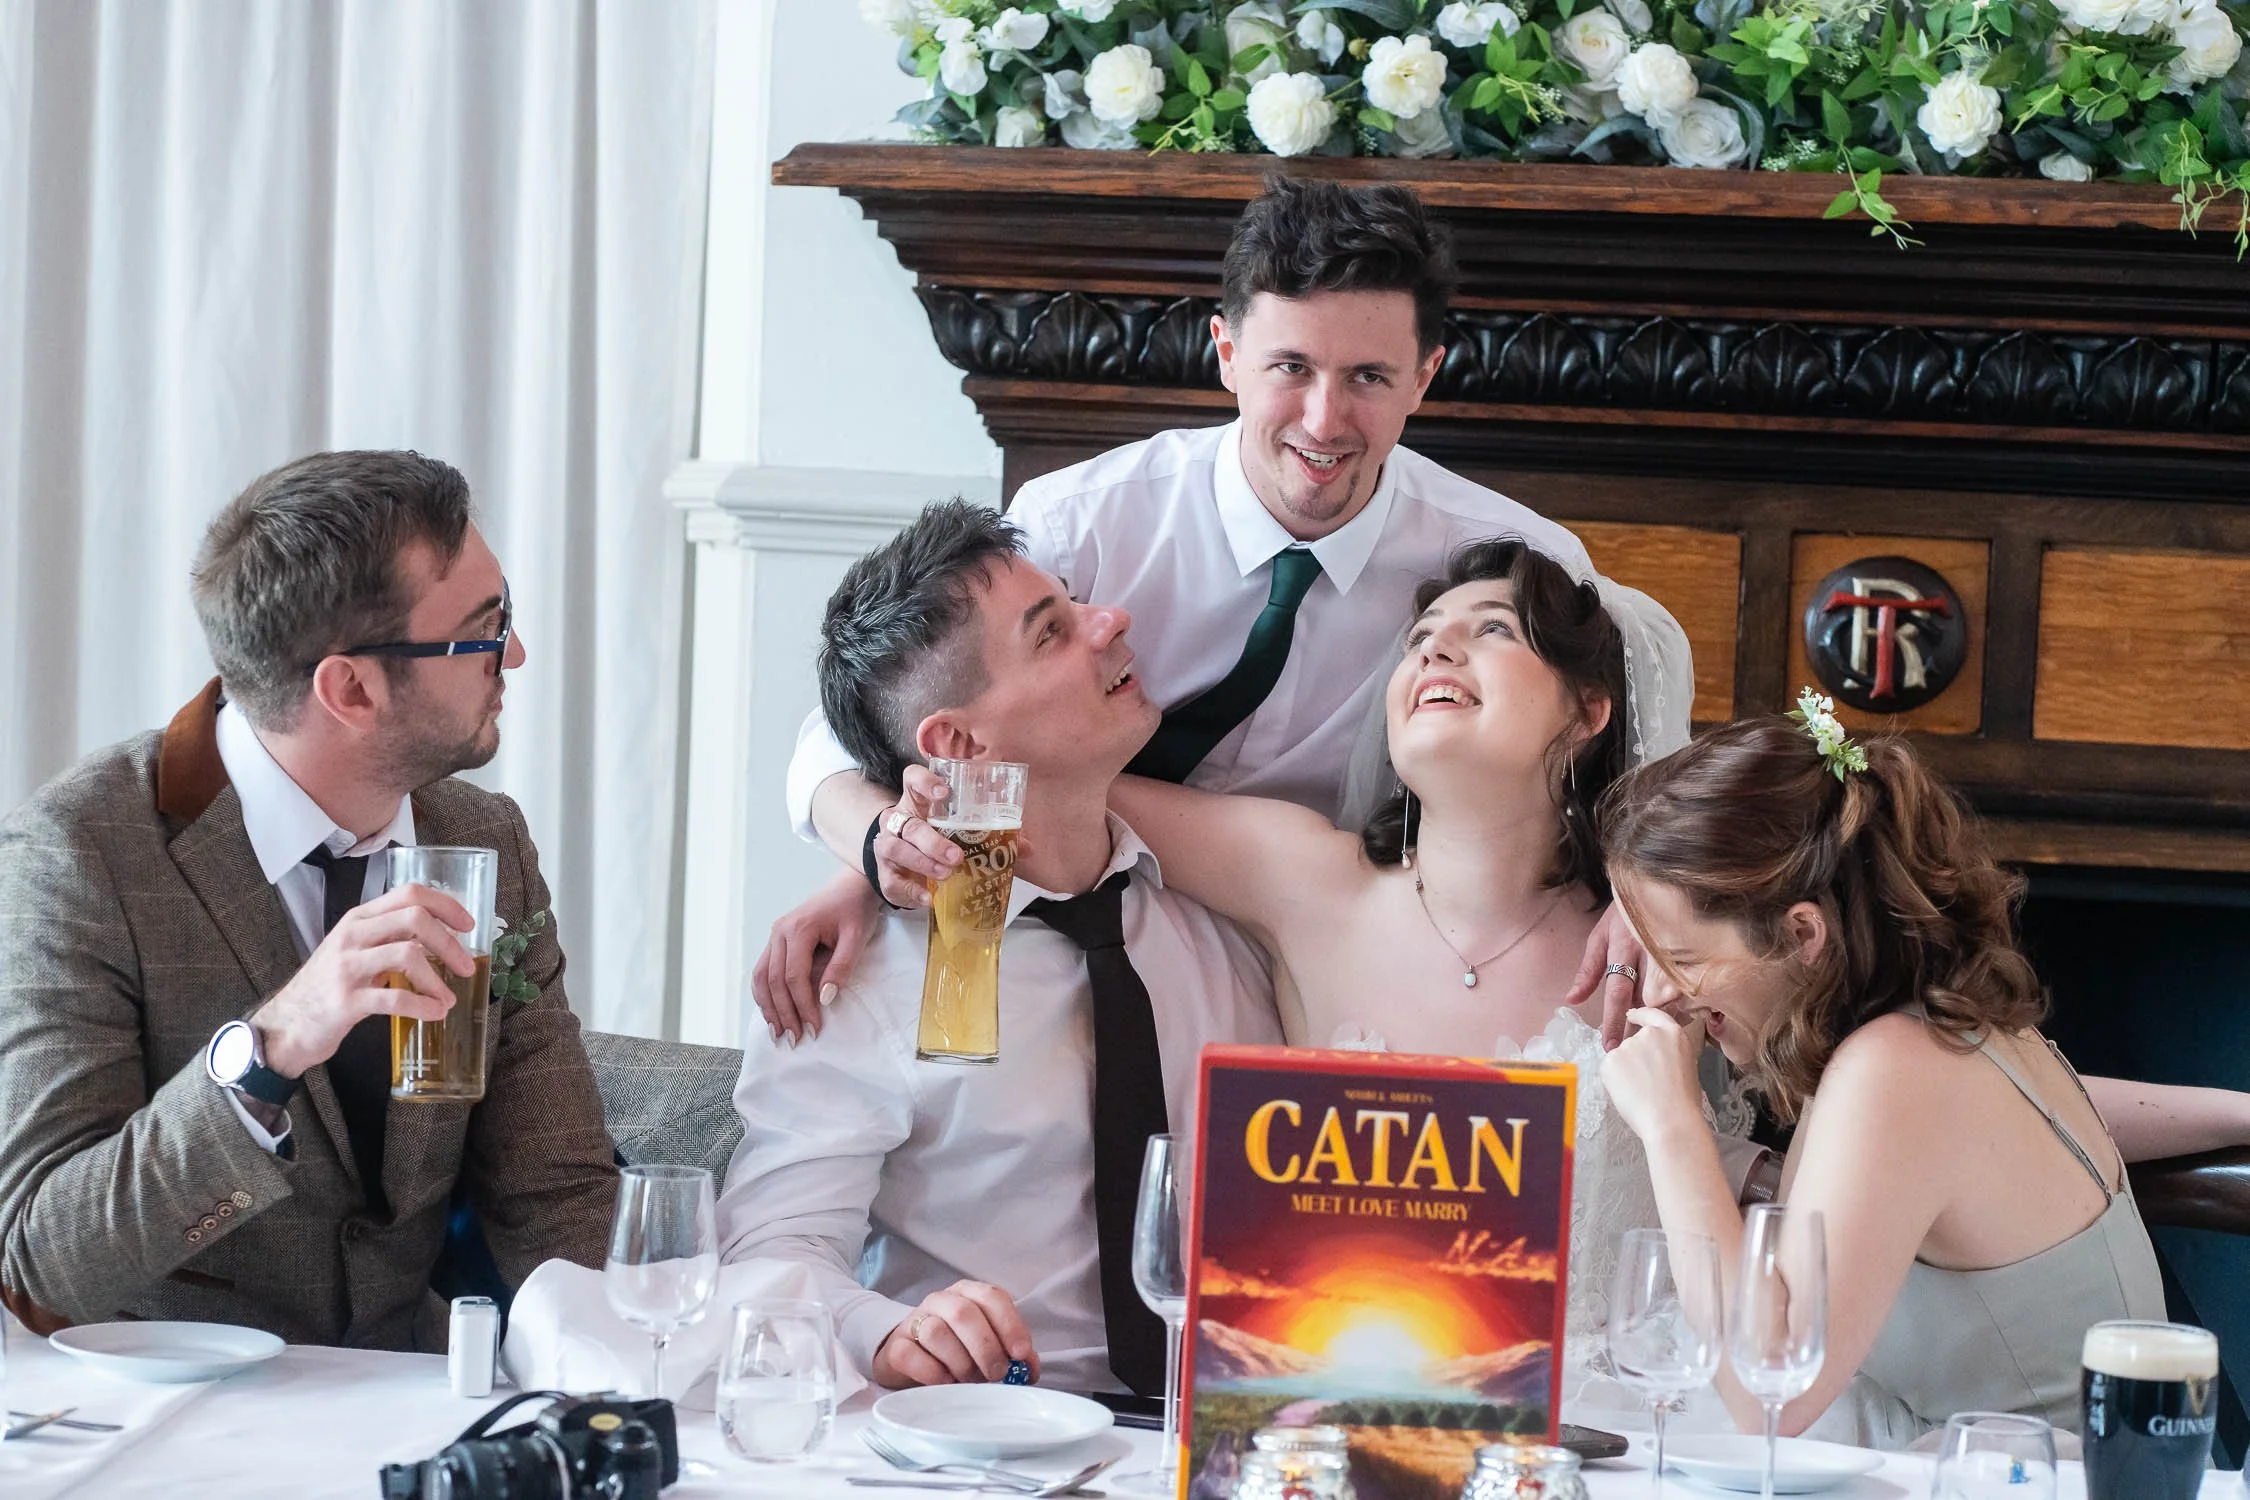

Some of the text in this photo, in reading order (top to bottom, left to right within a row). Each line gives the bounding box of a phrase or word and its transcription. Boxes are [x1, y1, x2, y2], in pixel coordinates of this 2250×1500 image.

[966, 840, 1018, 881] RON
[1245, 1099, 1530, 1197] CATAN
[1291, 1193, 1471, 1222] MEET LOVE MARRY
